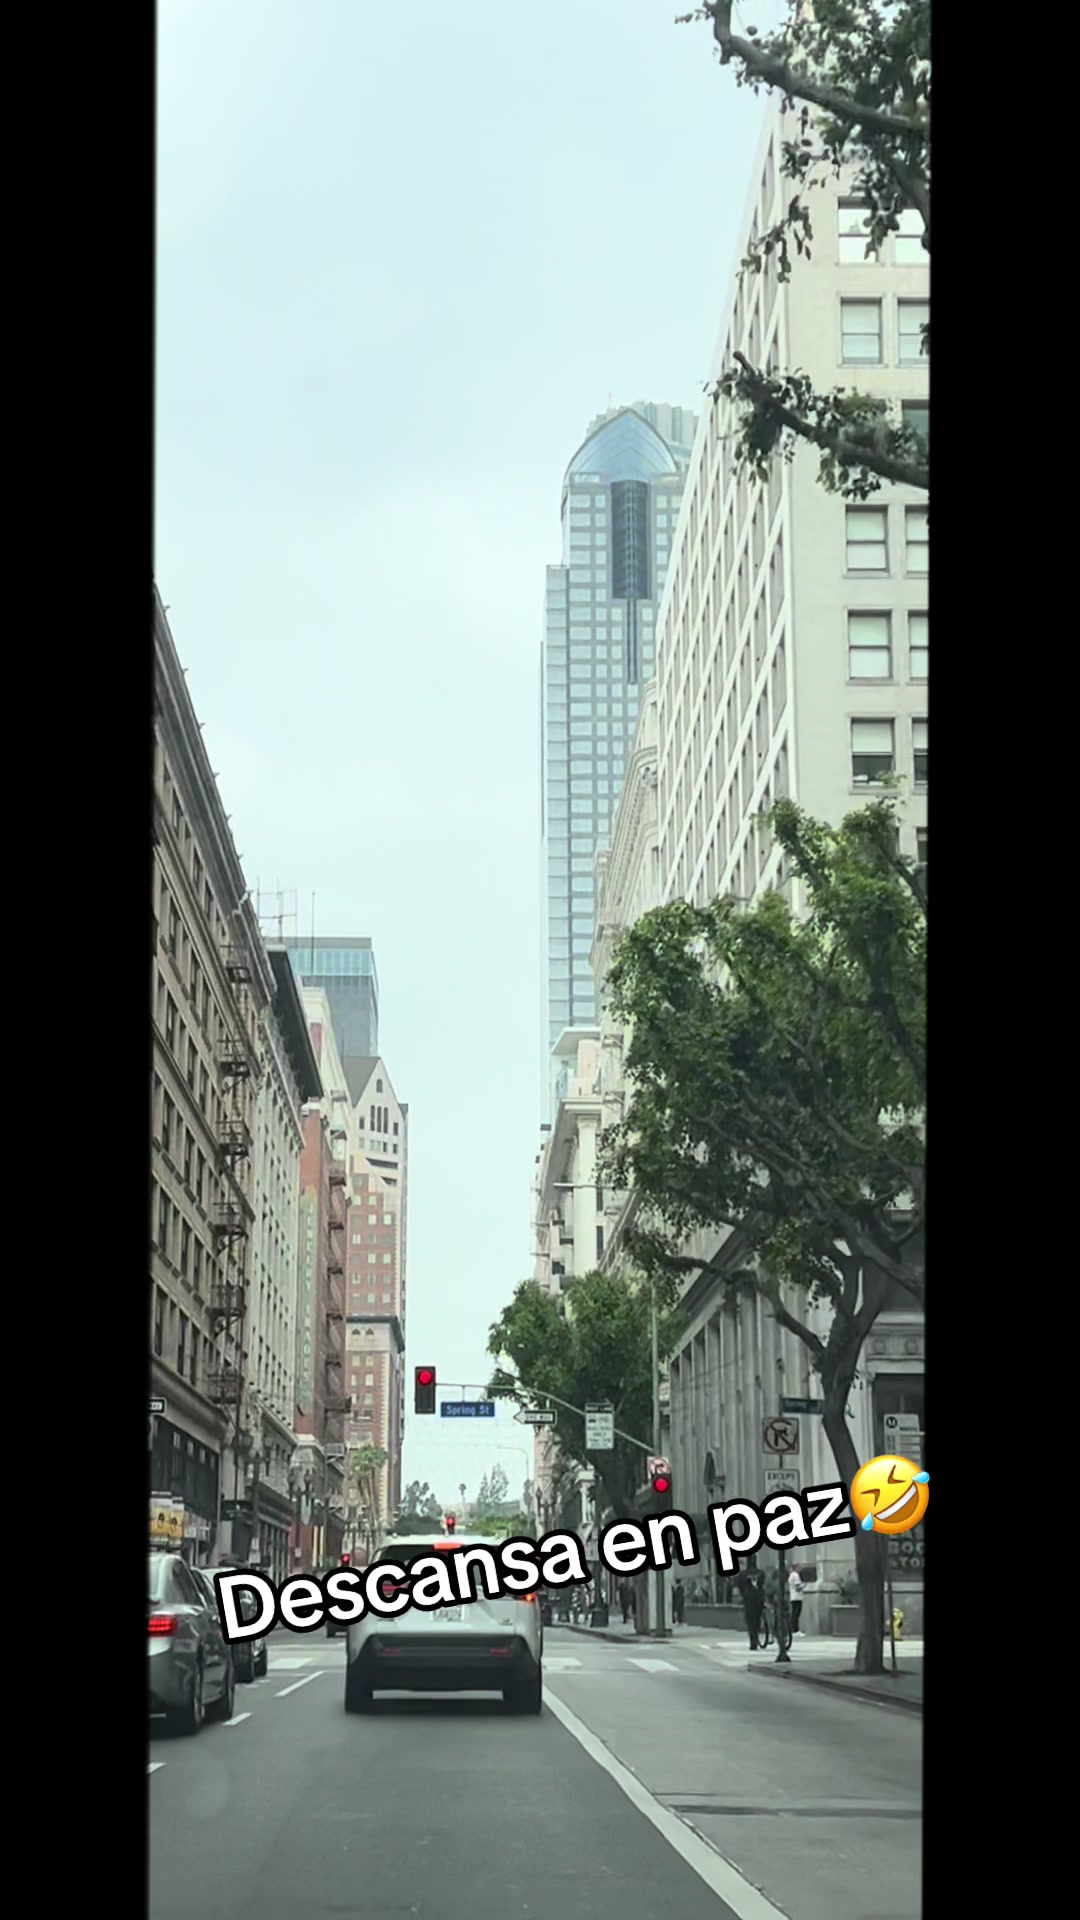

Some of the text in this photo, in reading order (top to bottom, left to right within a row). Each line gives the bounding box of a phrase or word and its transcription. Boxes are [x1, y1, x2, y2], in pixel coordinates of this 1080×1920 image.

[446, 1405, 490, 1416] Spring St
[767, 1472, 795, 1480] EXCEPT
